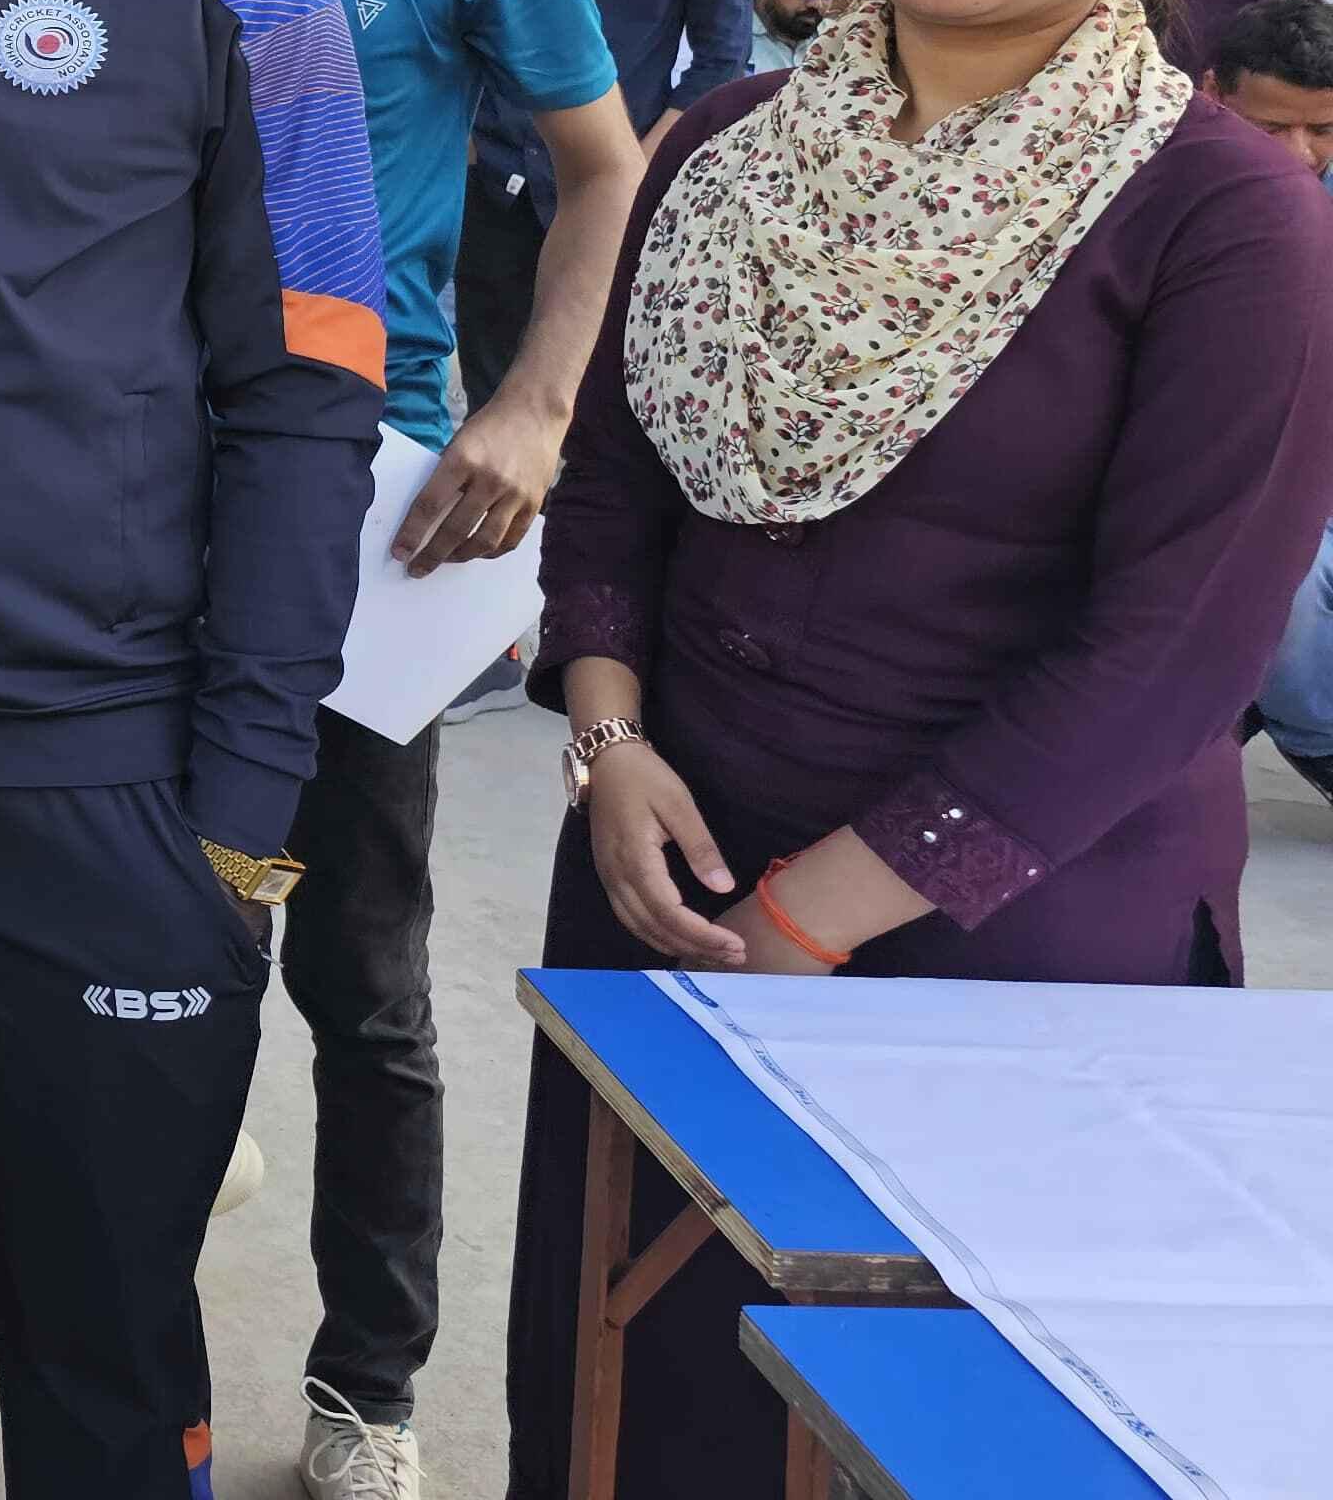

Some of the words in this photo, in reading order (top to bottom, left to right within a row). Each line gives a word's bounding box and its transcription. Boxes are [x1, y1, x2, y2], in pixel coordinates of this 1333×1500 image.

[9, 8, 62, 32] CRICKET
[4, 34, 23, 68] BIHAR
[57, 13, 92, 79] ASSOCIATION
